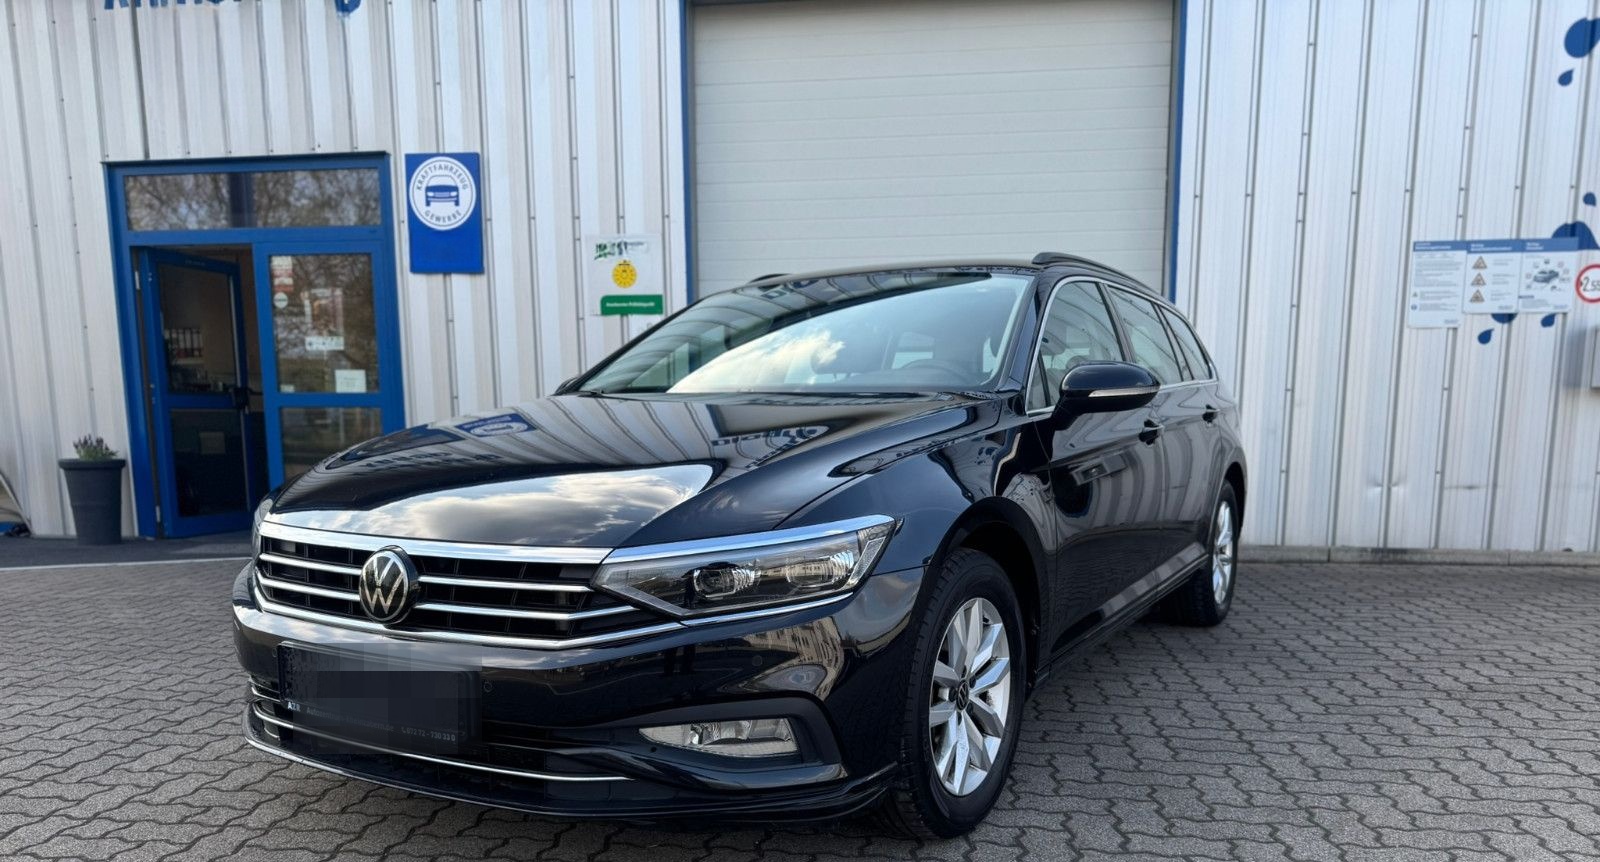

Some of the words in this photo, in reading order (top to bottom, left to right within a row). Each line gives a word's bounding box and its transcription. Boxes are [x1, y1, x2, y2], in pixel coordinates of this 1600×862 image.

[416, 163, 468, 191] KRAFTFAHRZEUG
[424, 210, 462, 223] GEWERBE
[287, 701, 301, 713] AZR
